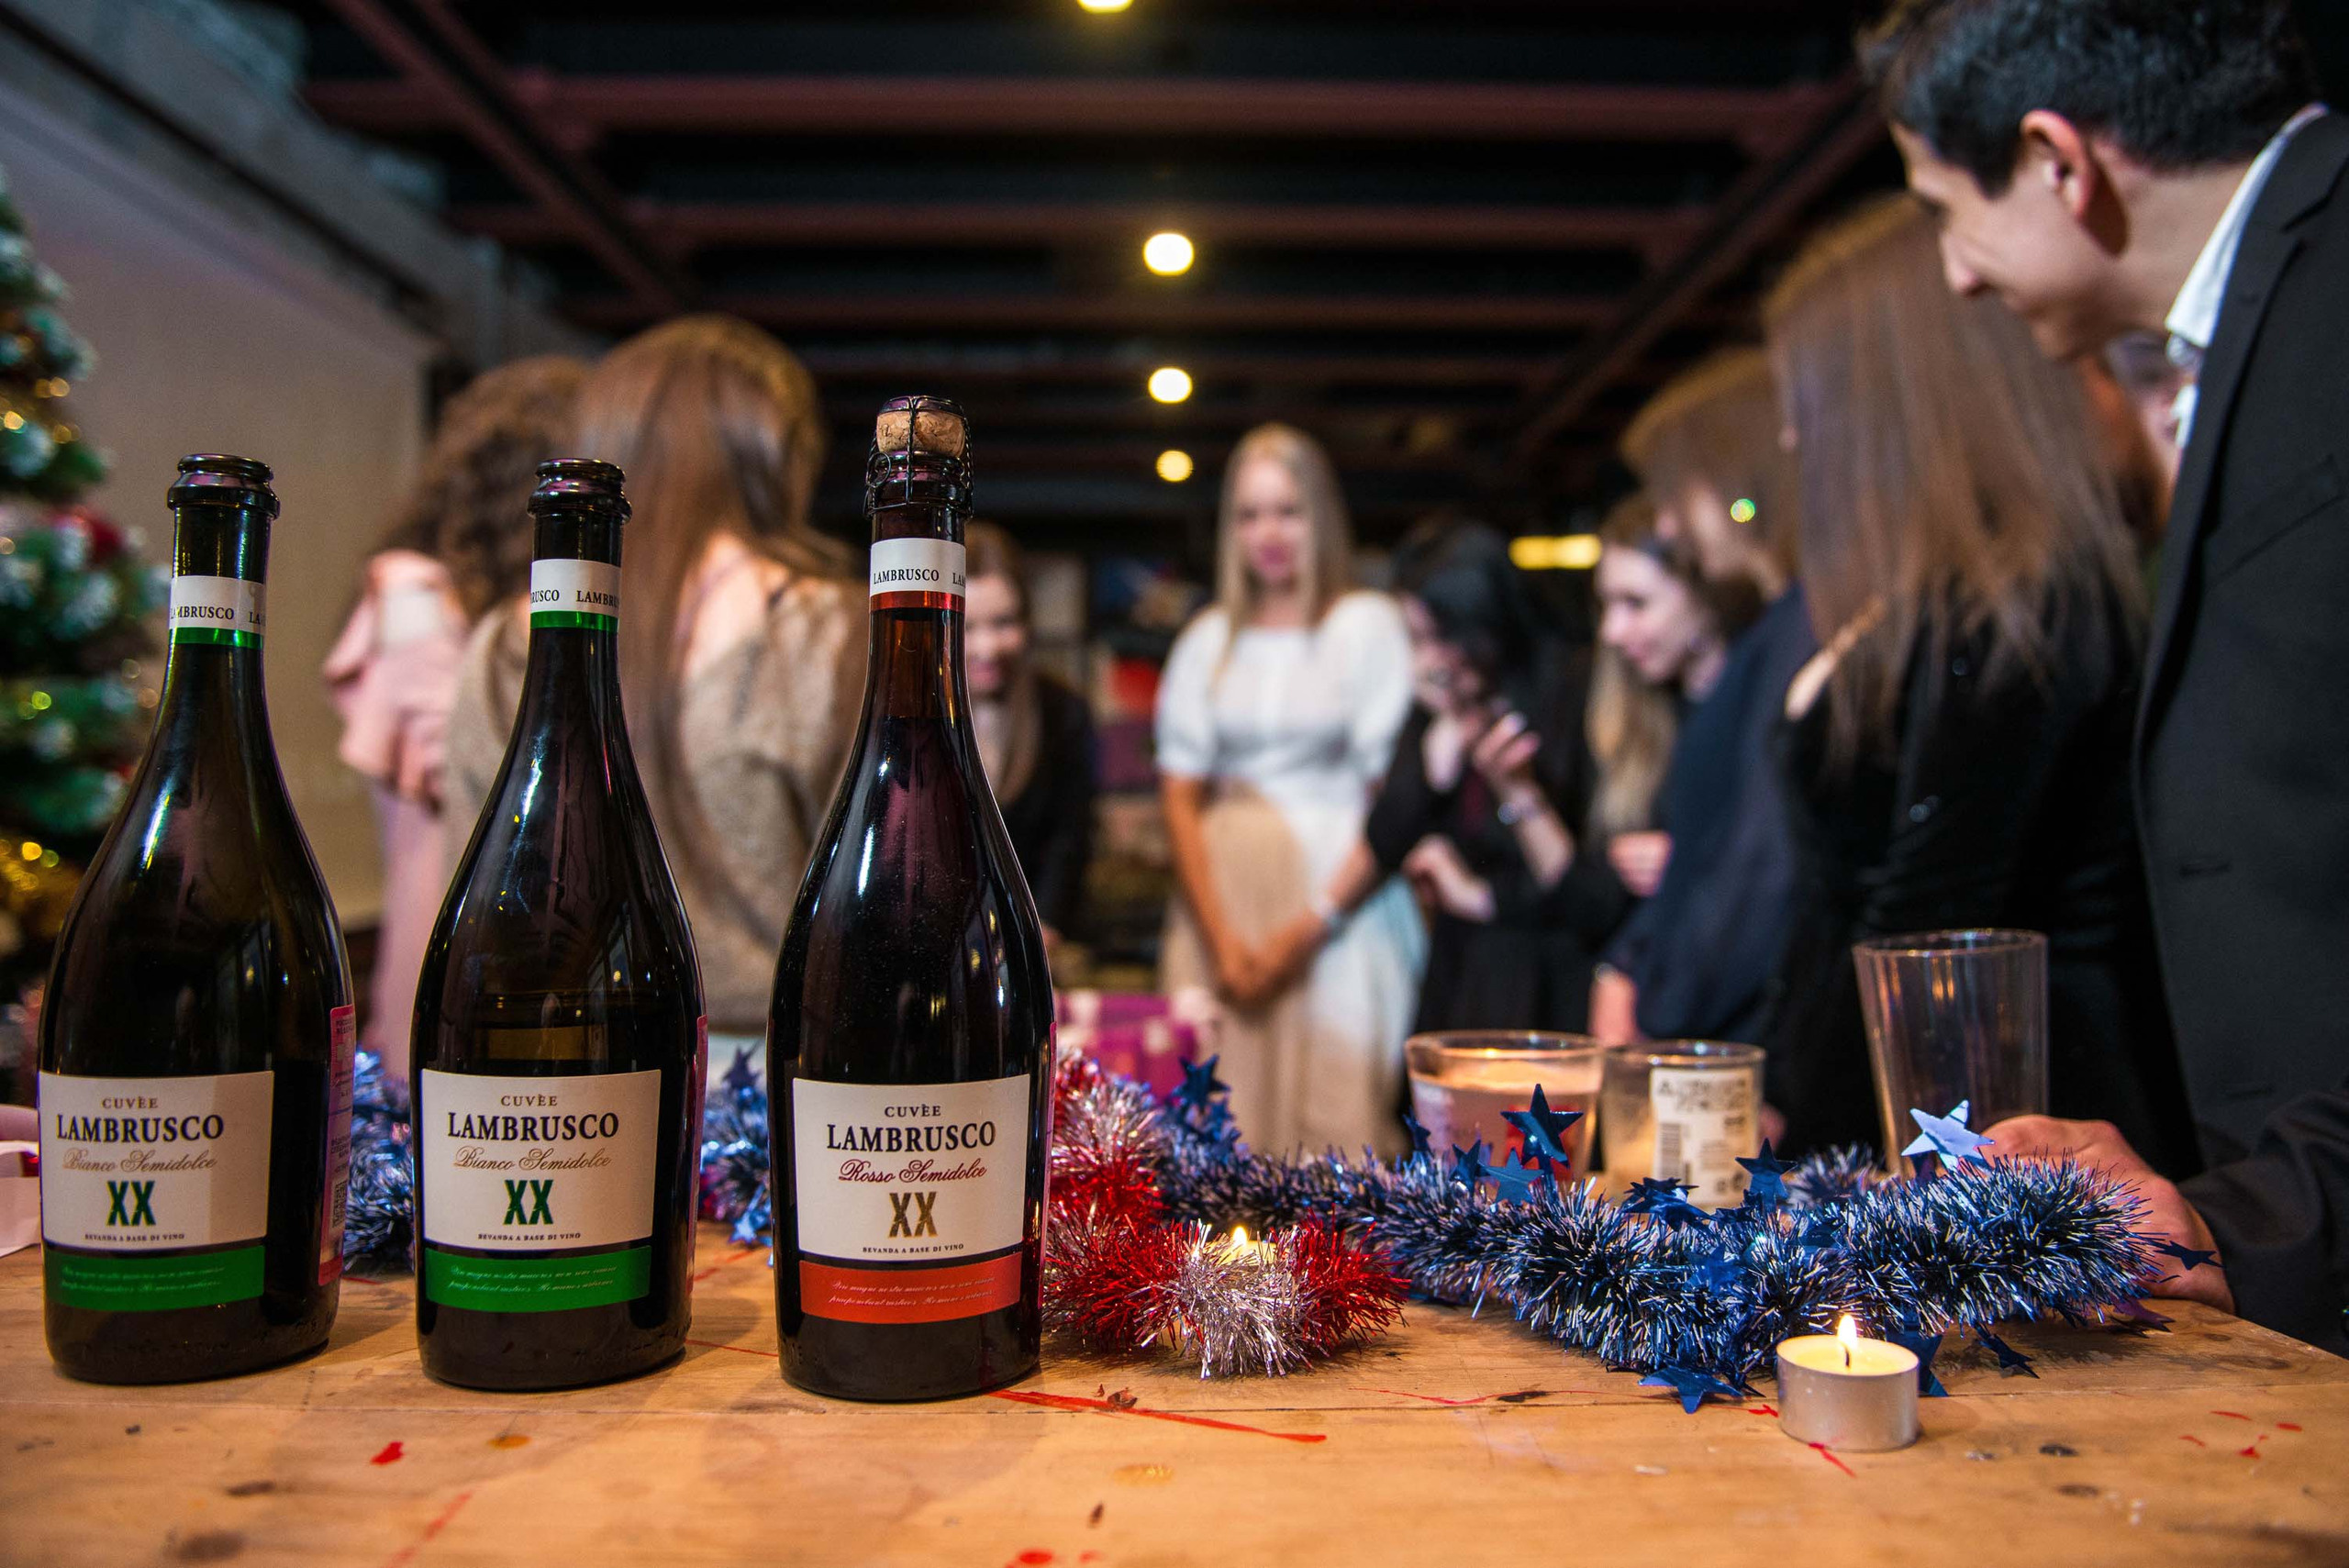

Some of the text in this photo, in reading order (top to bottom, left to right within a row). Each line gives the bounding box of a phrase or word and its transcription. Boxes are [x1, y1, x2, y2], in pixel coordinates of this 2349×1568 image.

[874, 568, 940, 584] LAMBRUSCO
[57, 1114, 224, 1143] LAMBRUSCO
[448, 1112, 619, 1142] LAMBRUSCO
[826, 1120, 996, 1152] LAMBRUSCO
[62, 1148, 217, 1173] Bianco Semidolce
[453, 1146, 612, 1171] Bianco Semidolce
[838, 1158, 987, 1184] Rosso Semidolce
[106, 1180, 157, 1227] XX
[503, 1179, 554, 1226] XX
[887, 1191, 939, 1239] XX
